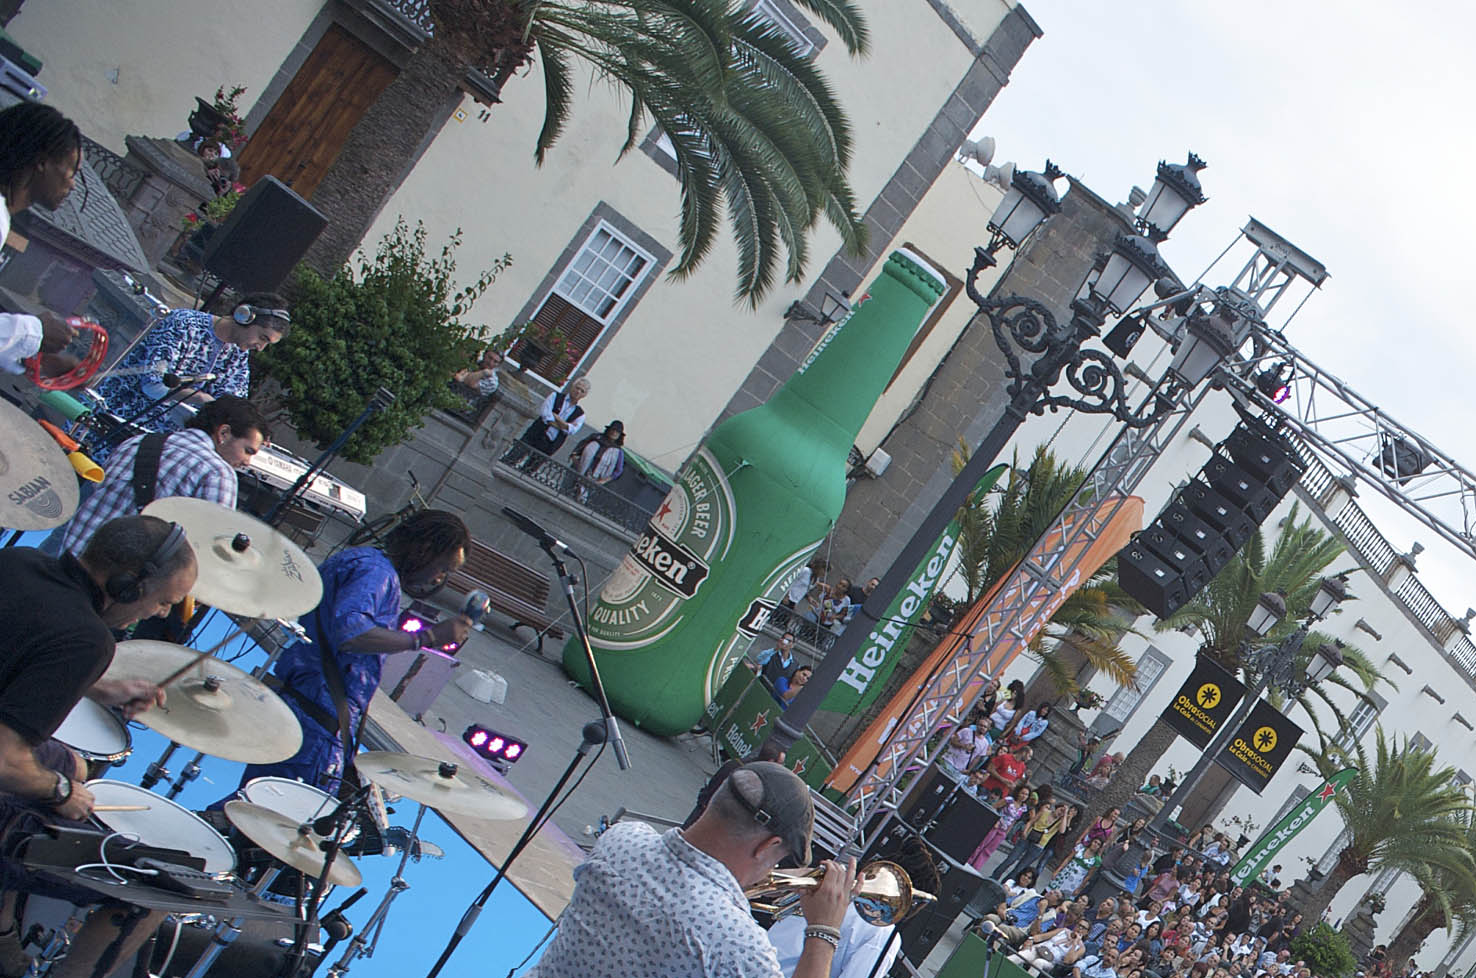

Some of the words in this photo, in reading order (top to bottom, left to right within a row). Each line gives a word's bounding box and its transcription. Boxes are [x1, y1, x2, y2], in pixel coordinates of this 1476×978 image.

[478, 109, 491, 123] 11
[8, 475, 52, 505] SABIAN
[691, 503, 710, 538] BEER
[633, 532, 684, 585] eken
[593, 599, 650, 625] QUALITY
[837, 534, 954, 694] Heineken
